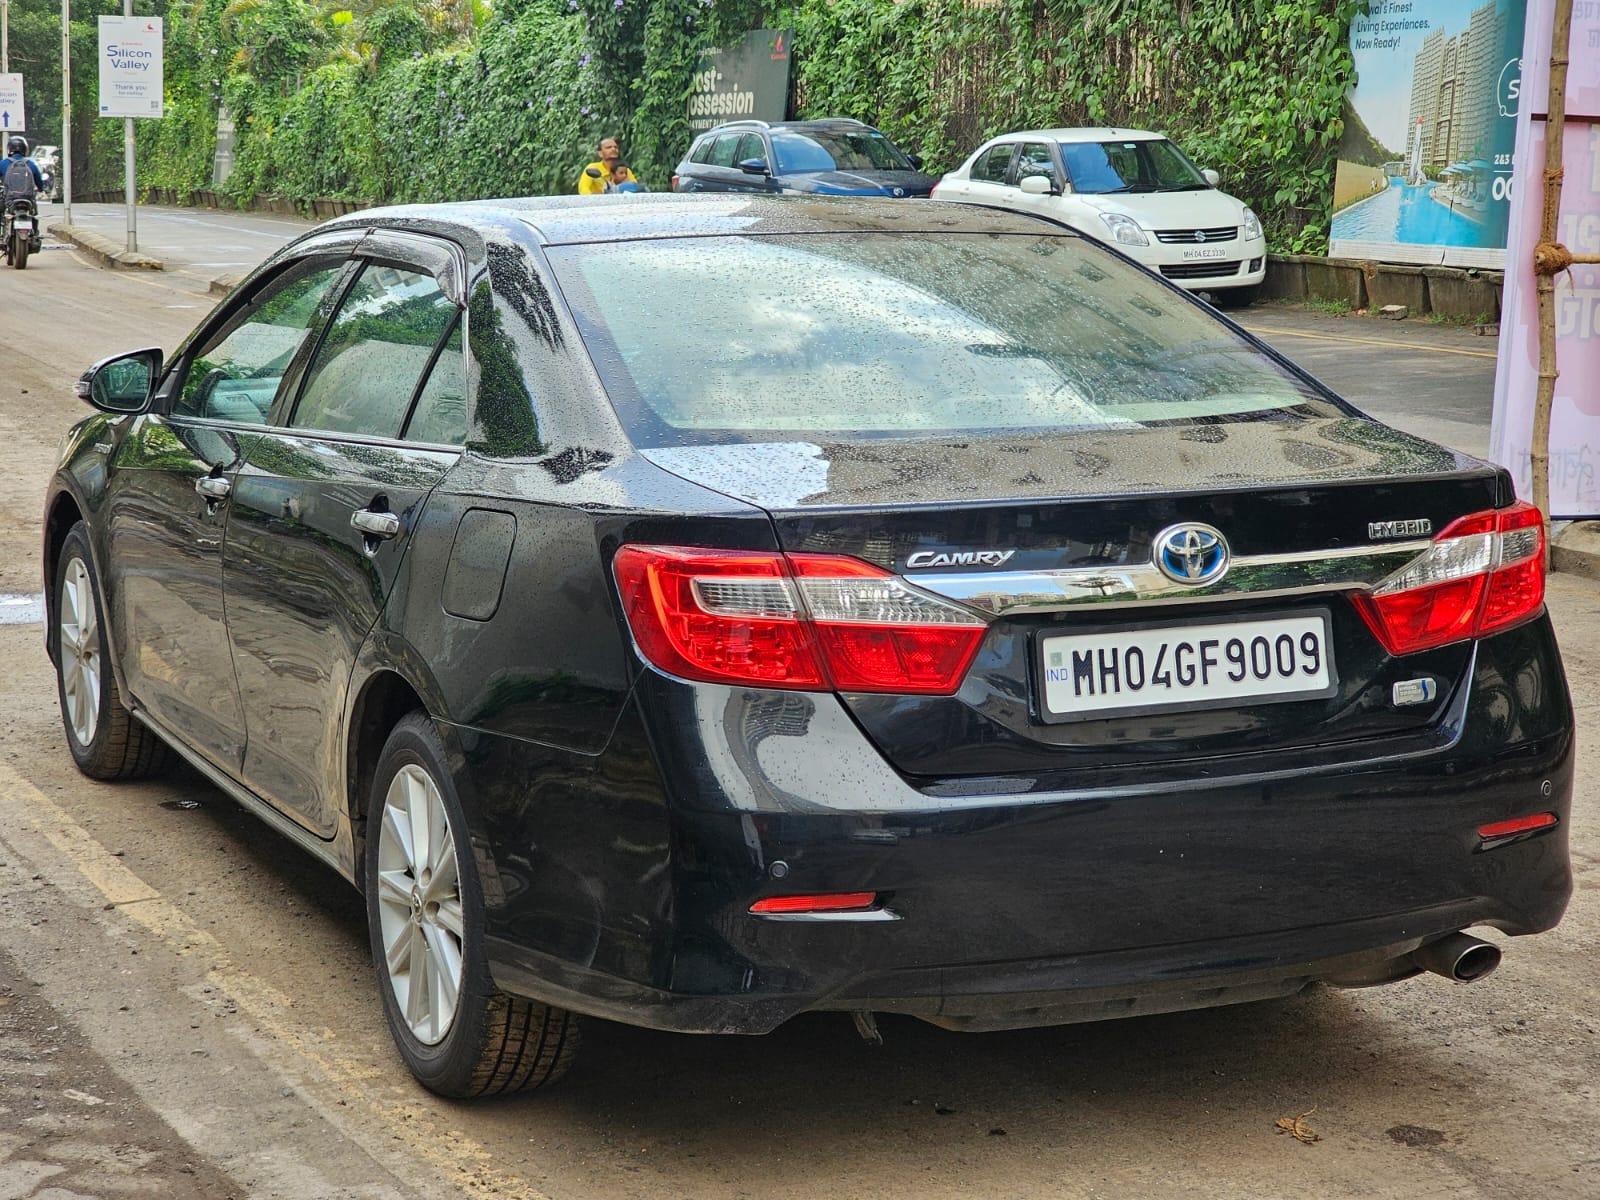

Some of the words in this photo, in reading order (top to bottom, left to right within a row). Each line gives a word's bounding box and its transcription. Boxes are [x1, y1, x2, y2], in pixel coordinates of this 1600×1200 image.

[1389, 2, 1412, 14] Finest
[1357, 19, 1379, 35] Living
[1381, 18, 1430, 34] Experiences.
[106, 45, 152, 58] Silicon
[1355, 38, 1372, 50] Now
[1373, 36, 1401, 51] Ready!
[111, 59, 150, 71] Valley
[692, 65, 722, 93] ost-
[687, 83, 754, 117] ossession
[1368, 518, 1431, 539] HYBRID
[1072, 631, 1321, 697] MH04GF9009
[1046, 666, 1068, 682] IND
